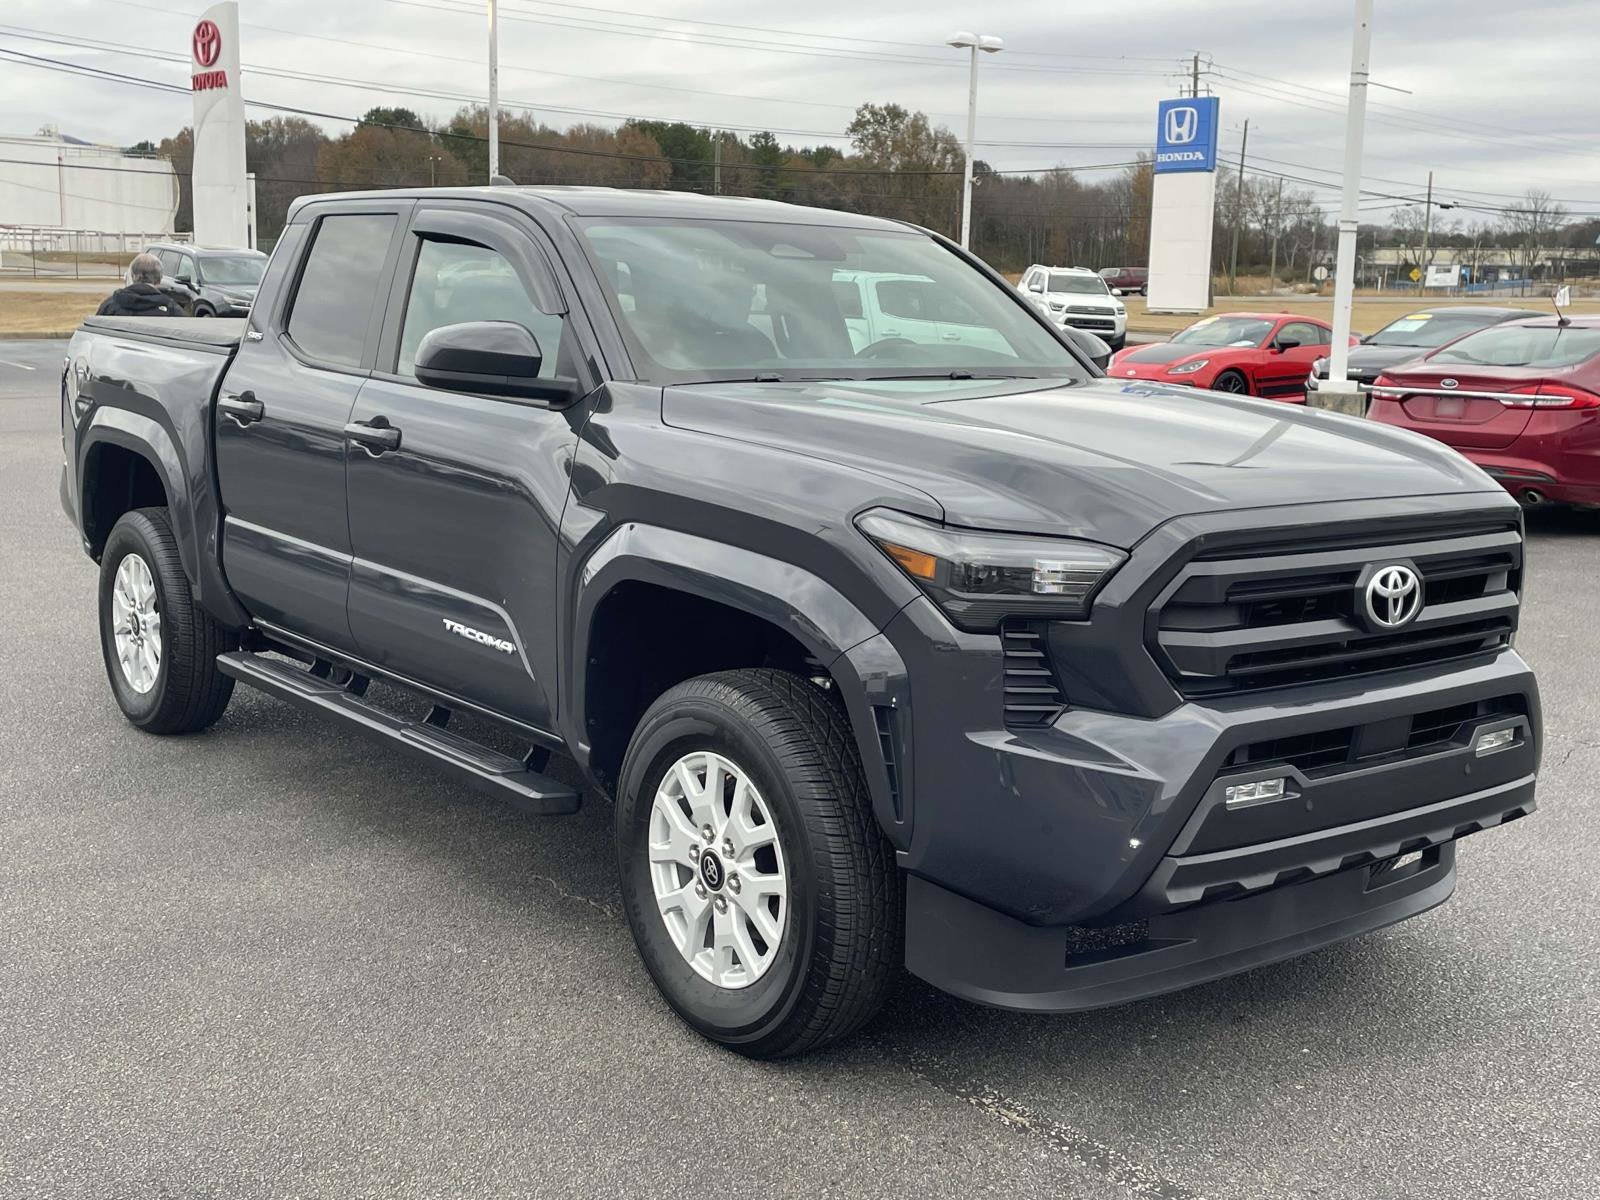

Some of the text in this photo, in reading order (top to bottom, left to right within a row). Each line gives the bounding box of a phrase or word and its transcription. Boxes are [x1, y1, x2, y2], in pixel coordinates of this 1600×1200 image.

[191, 71, 228, 91] TOYOTA
[1157, 151, 1205, 163] HONDA
[443, 618, 517, 655] TACOMA
